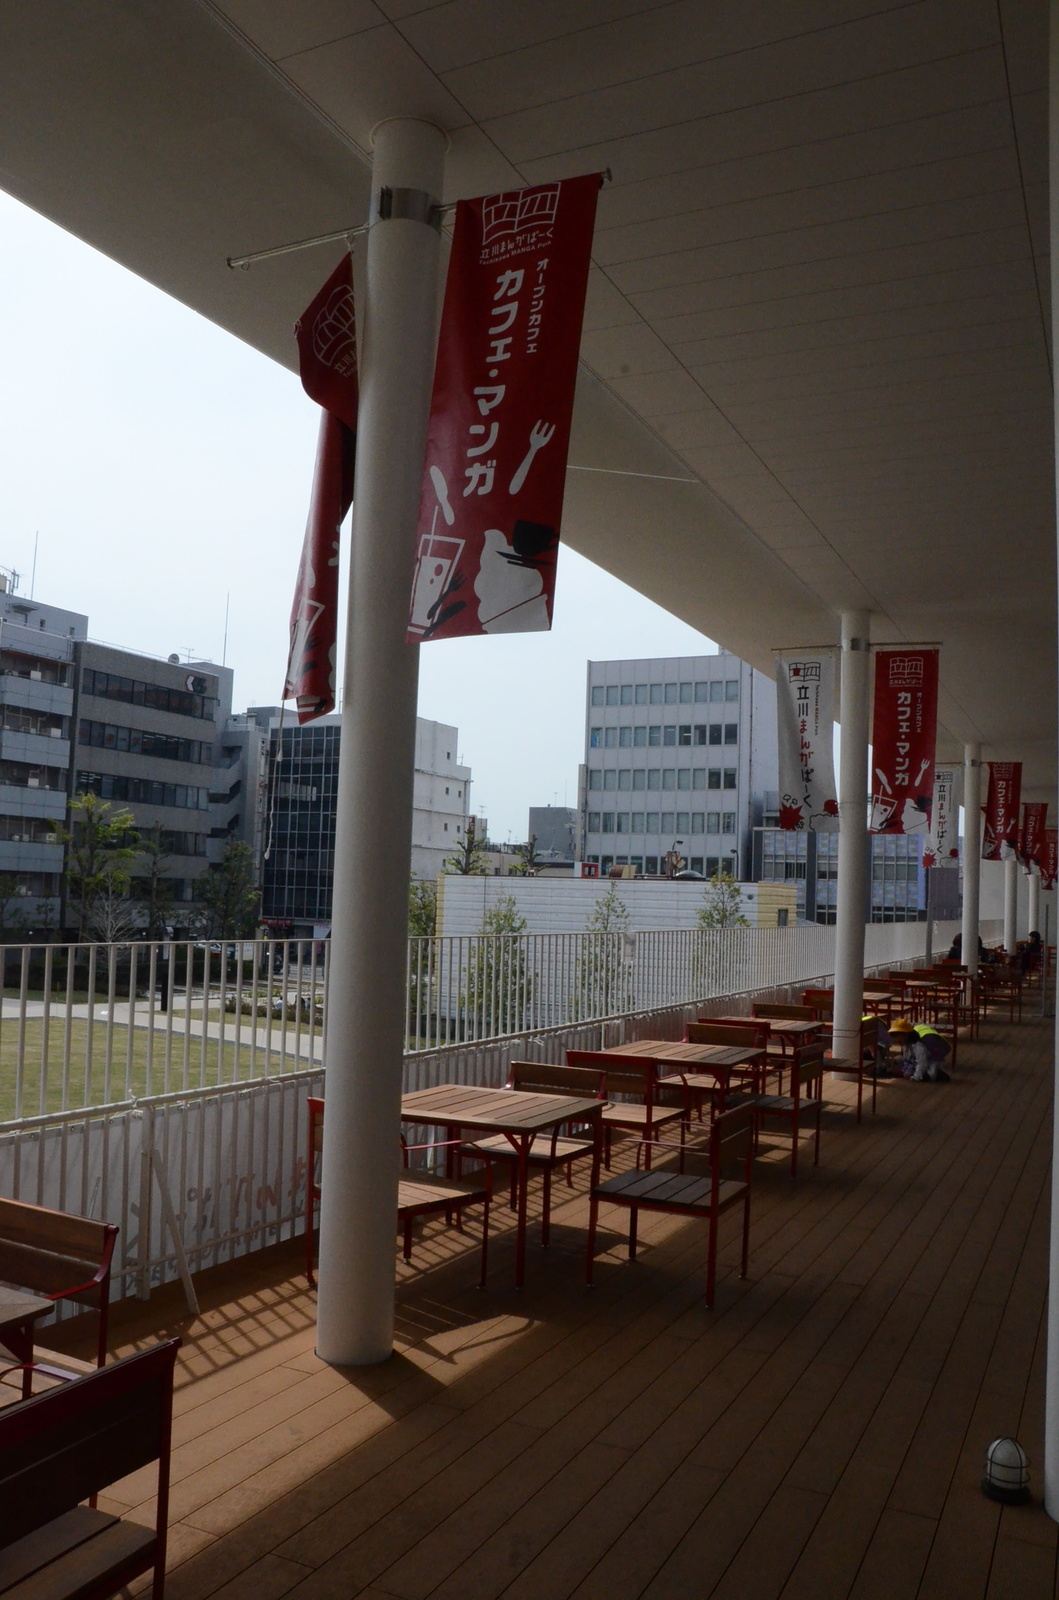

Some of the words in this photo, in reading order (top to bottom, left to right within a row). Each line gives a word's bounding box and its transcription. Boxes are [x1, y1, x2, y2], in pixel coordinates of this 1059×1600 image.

[511, 245, 536, 257] MANGA
[526, 258, 549, 354] オープンカフェ
[462, 269, 525, 498] カフェ・マンガ
[797, 685, 814, 808] 立川まんがぱーく
[895, 691, 911, 786] カフェ・マンガ
